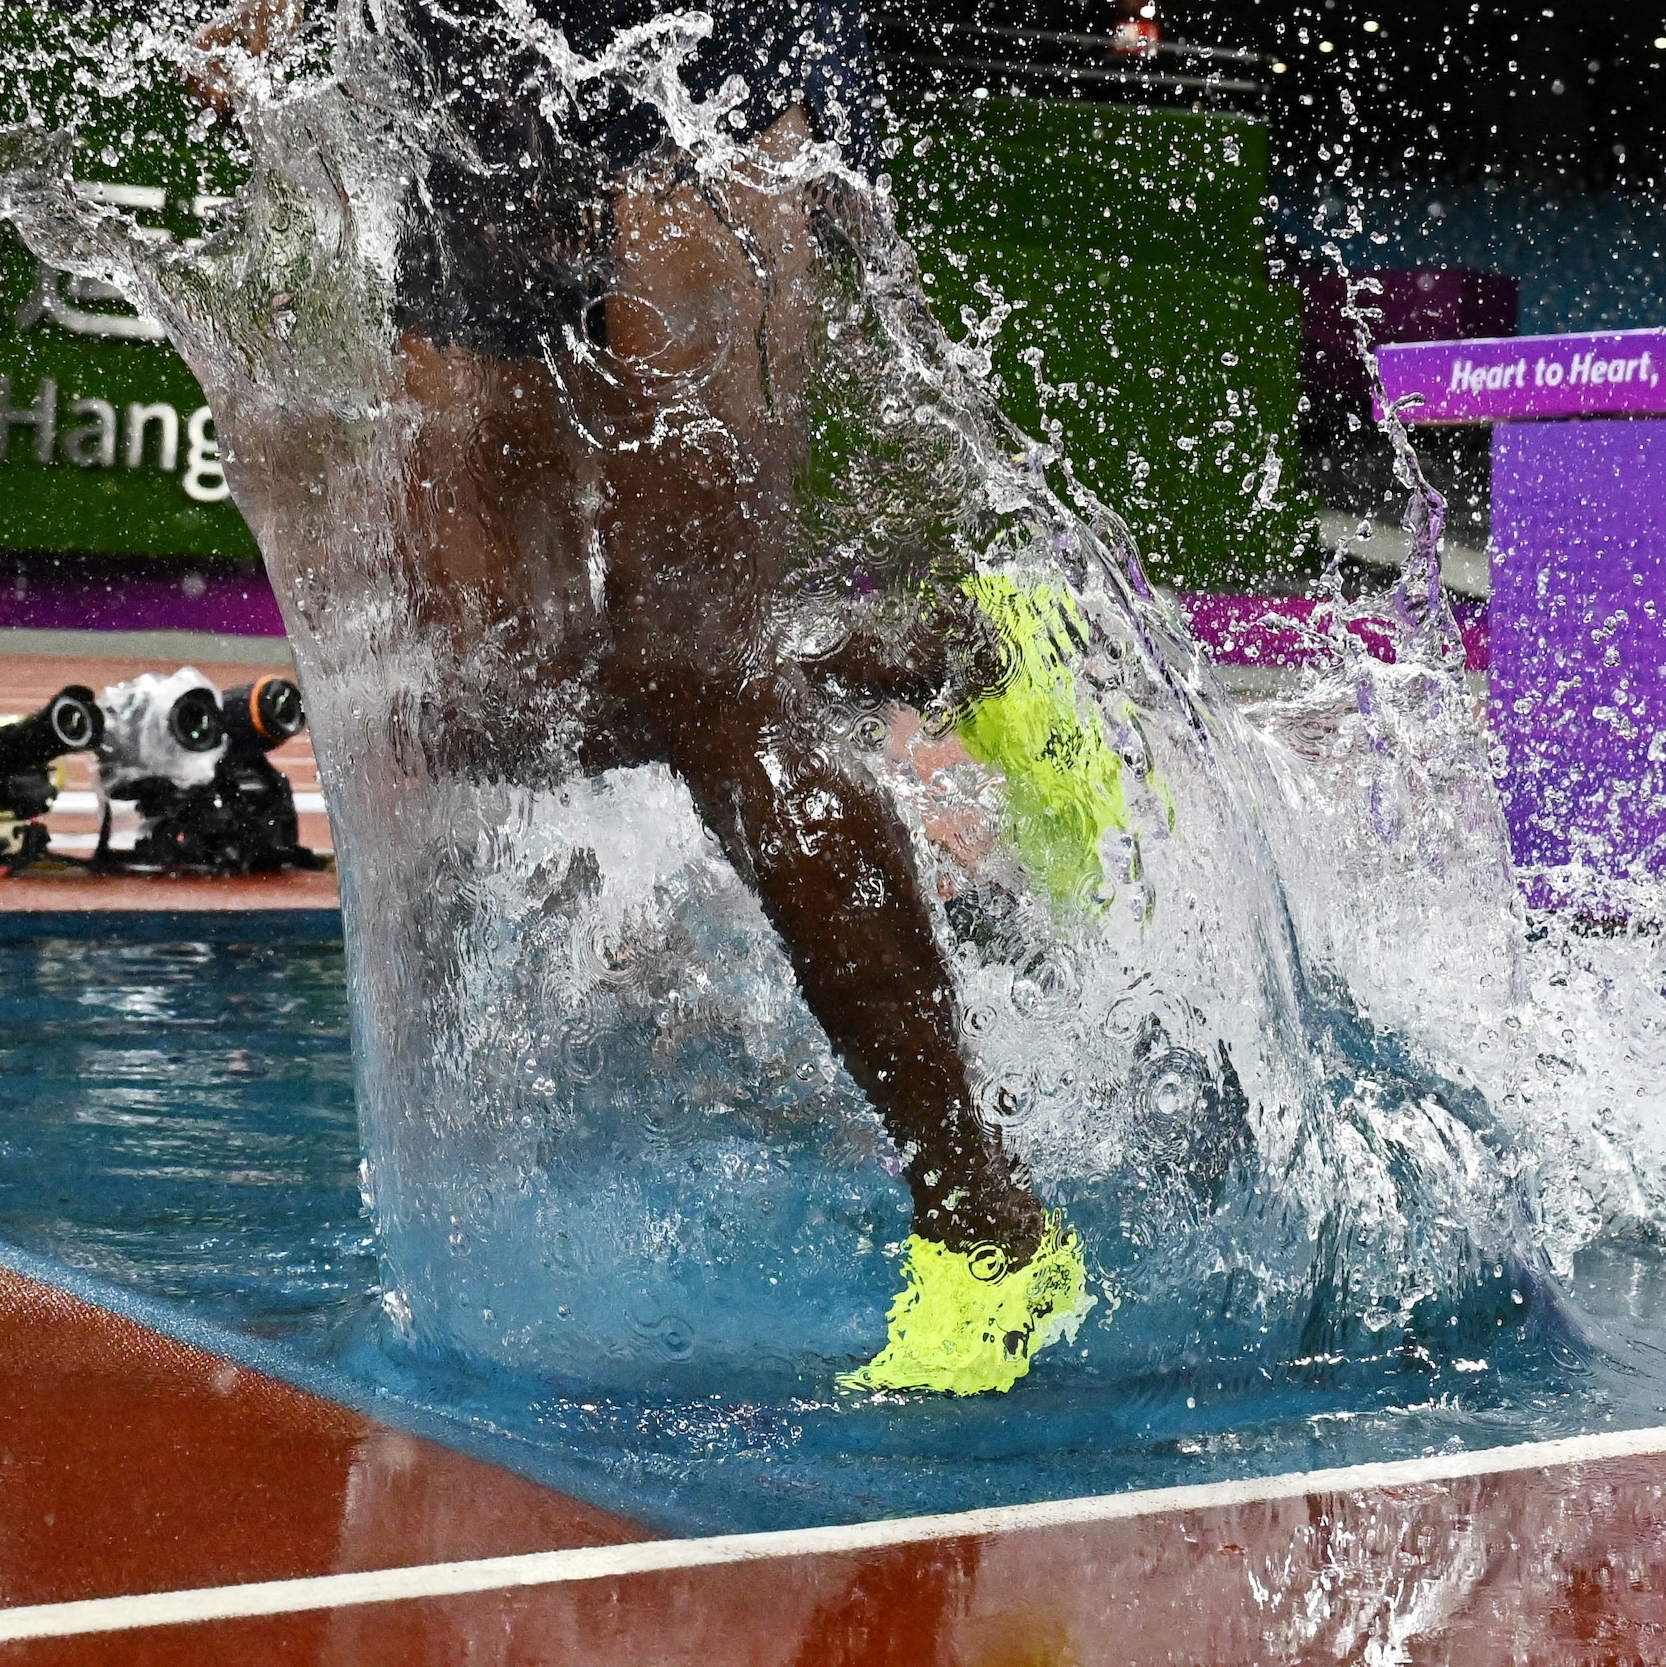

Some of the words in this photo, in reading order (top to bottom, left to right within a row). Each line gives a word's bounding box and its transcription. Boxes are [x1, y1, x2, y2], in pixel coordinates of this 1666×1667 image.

[1450, 360, 1526, 392] Heart
[1535, 357, 1563, 387] to
[1570, 352, 1659, 388] Heart,
